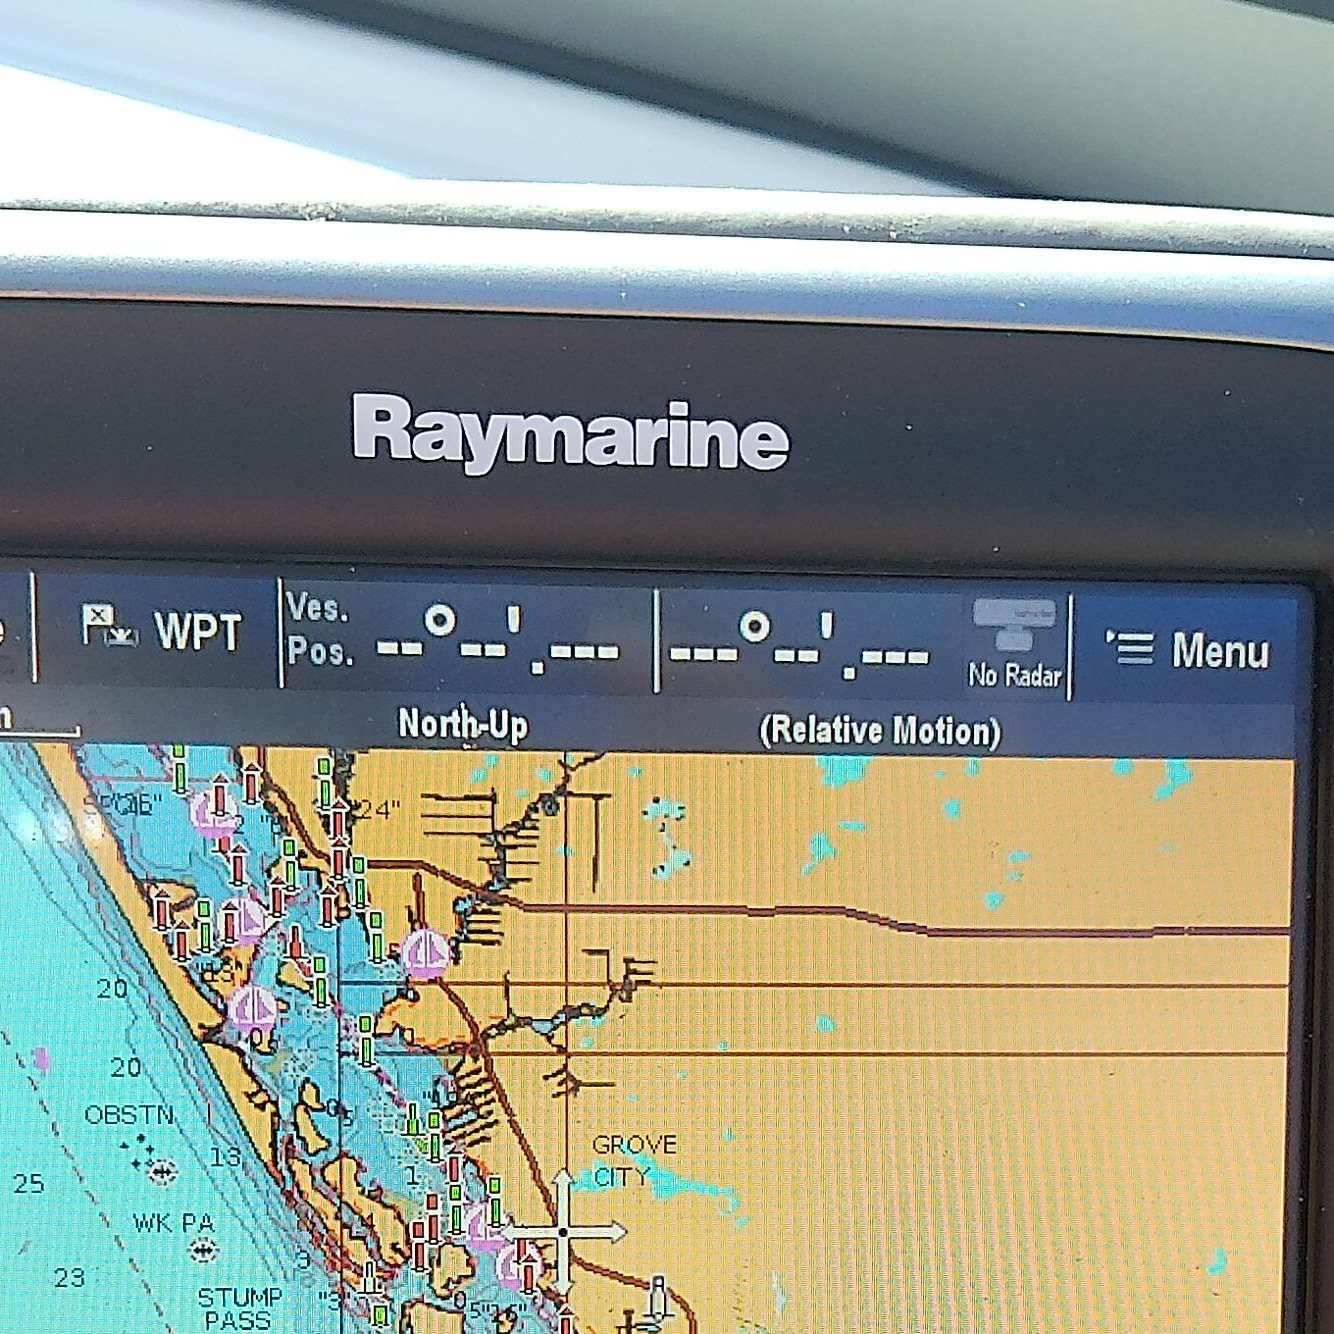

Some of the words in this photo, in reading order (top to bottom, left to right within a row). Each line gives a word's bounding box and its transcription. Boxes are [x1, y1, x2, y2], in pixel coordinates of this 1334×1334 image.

[352, 393, 791, 477] Raymarine
[286, 590, 348, 623] Ves.
[154, 612, 243, 652] WPT
[287, 635, 354, 666] Pos.
[1173, 631, 1269, 668] Menu
[969, 661, 997, 687] No
[1006, 661, 1063, 688] Radar
[399, 707, 529, 741] North-Up
[760, 713, 883, 750] (Relative
[893, 715, 1002, 752] Motion)
[97, 978, 128, 1000] 20
[110, 1057, 142, 1078] 20
[84, 1104, 174, 1125] OBSTN
[592, 1134, 678, 1155] GROVE
[210, 1147, 242, 1168] 13
[13, 1173, 45, 1195] 25
[594, 1166, 650, 1188] CITY
[132, 1212, 173, 1233] WK
[182, 1212, 216, 1233] PA
[54, 1267, 86, 1289] 23
[198, 1287, 283, 1307] STUMP
[205, 1310, 272, 1331] PASS
